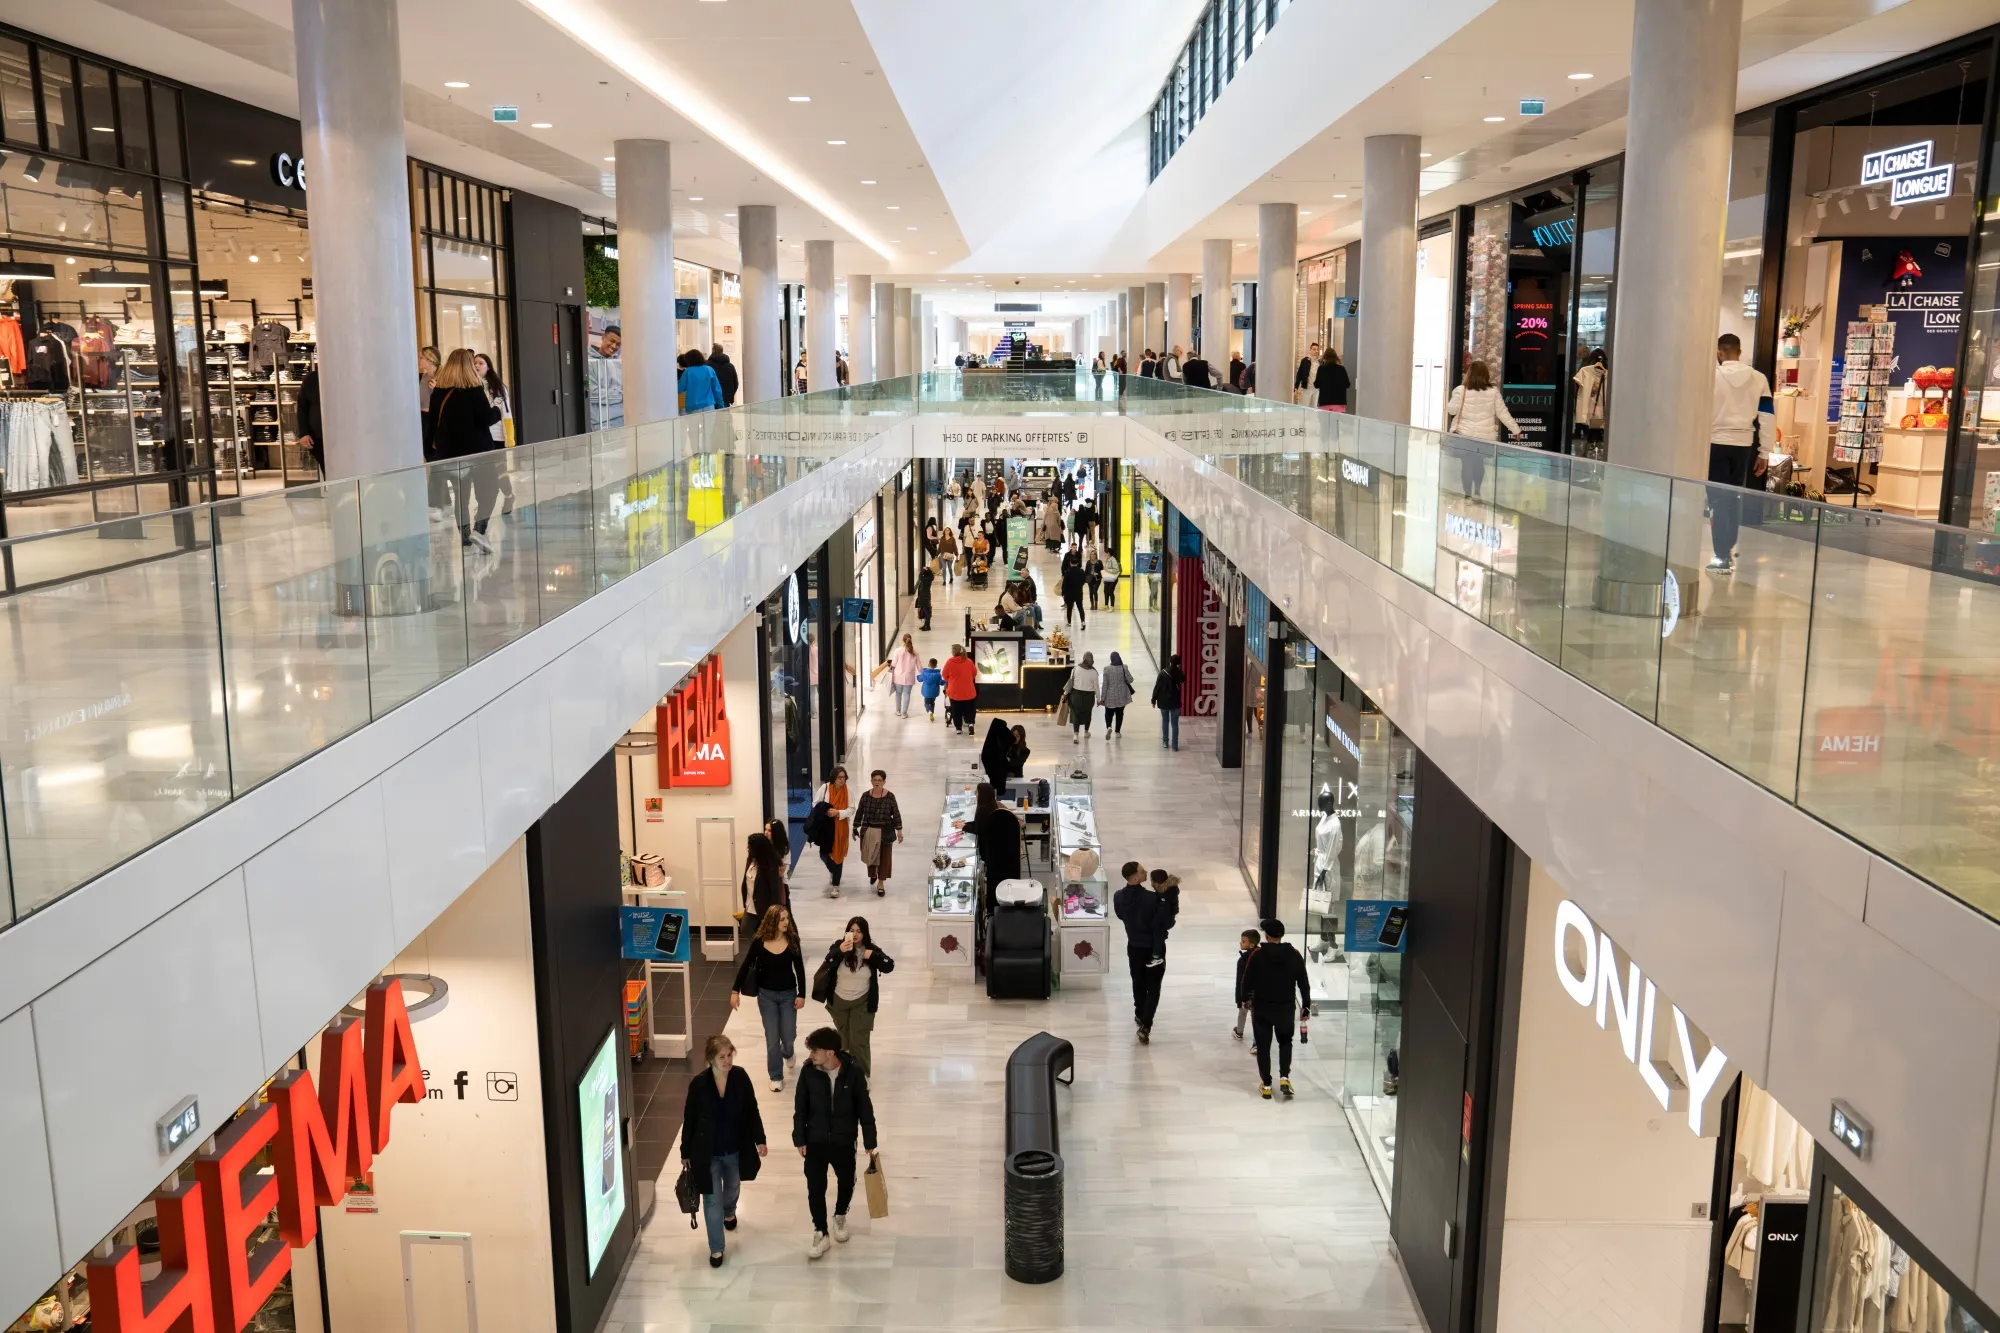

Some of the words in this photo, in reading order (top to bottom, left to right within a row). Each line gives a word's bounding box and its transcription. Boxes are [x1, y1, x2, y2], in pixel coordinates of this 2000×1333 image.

[1866, 160, 1880, 178] LA
[1885, 148, 1927, 173] CHAISE
[1896, 172, 1948, 199] LONGUE
[1891, 296, 1907, 307] LA
[1914, 295, 1960, 307] CHAISE
[1516, 317, 1548, 329] -20%
[942, 433, 963, 443] 1H30
[966, 433, 978, 443] DE
[981, 433, 1022, 443] PARKING
[1194, 586, 1220, 716] Superdry
[656, 652, 727, 790] HEMA
[692, 743, 726, 761] MA
[1554, 899, 1729, 1139] ONLY
[86, 977, 427, 1333] HEMA
[1767, 1232, 1799, 1242] ONLY
